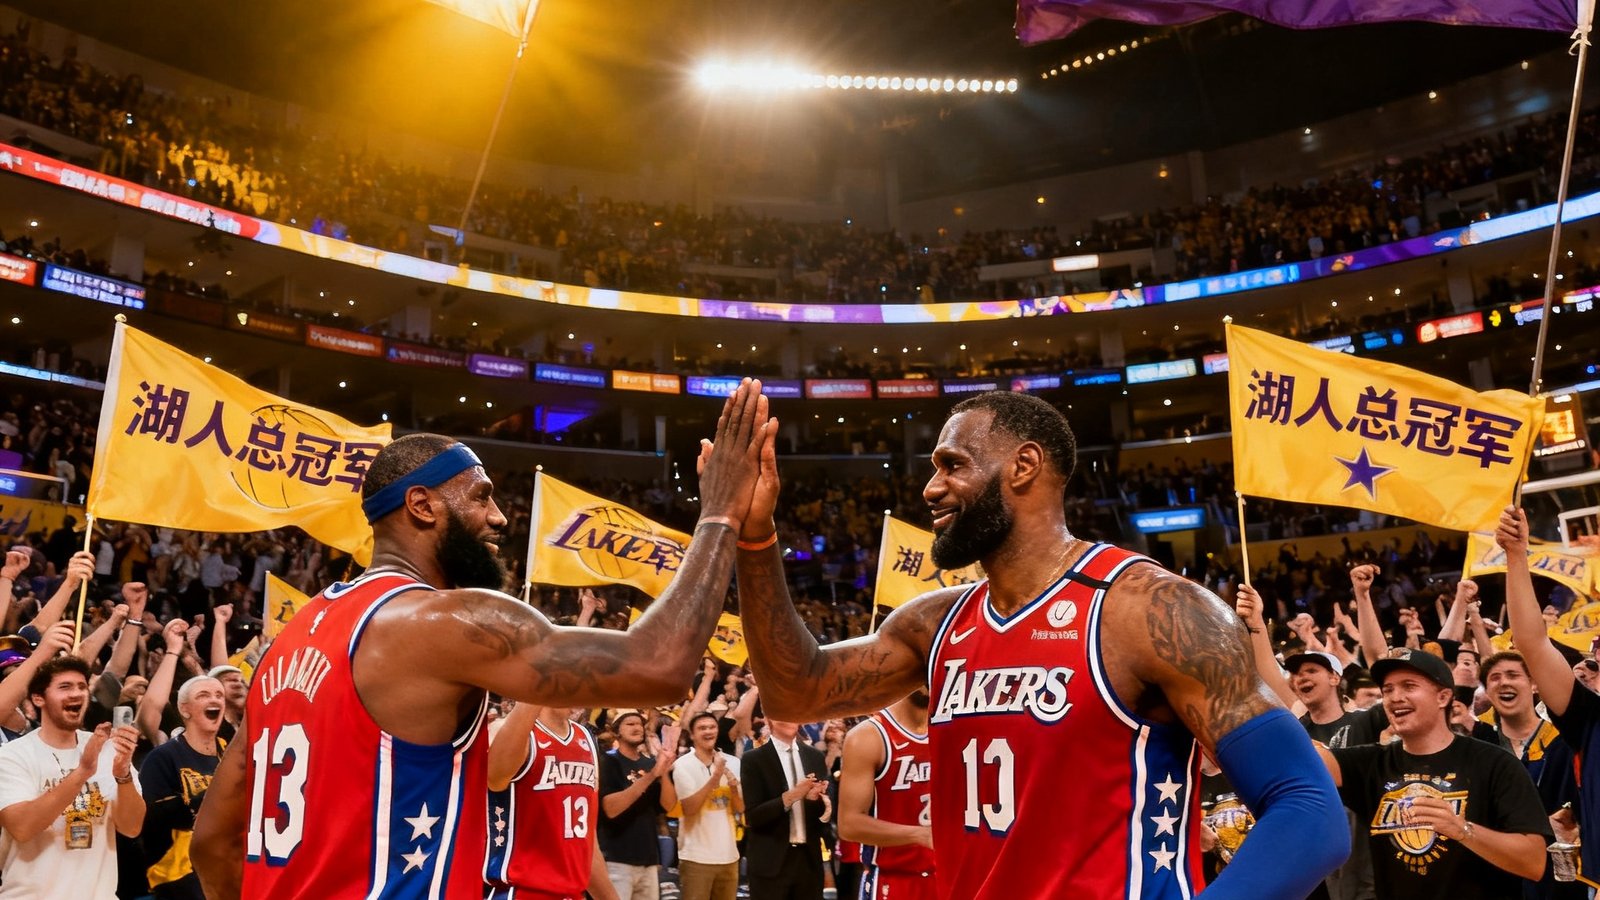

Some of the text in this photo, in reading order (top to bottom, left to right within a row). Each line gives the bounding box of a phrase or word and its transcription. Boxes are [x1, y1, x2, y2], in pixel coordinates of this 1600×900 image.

[125, 381, 384, 493] 湖人总冠军
[1244, 368, 1523, 469] 湖人总冠军
[930, 658, 1075, 726] LAKERS
[247, 723, 311, 866] 13
[562, 795, 589, 839] 13
